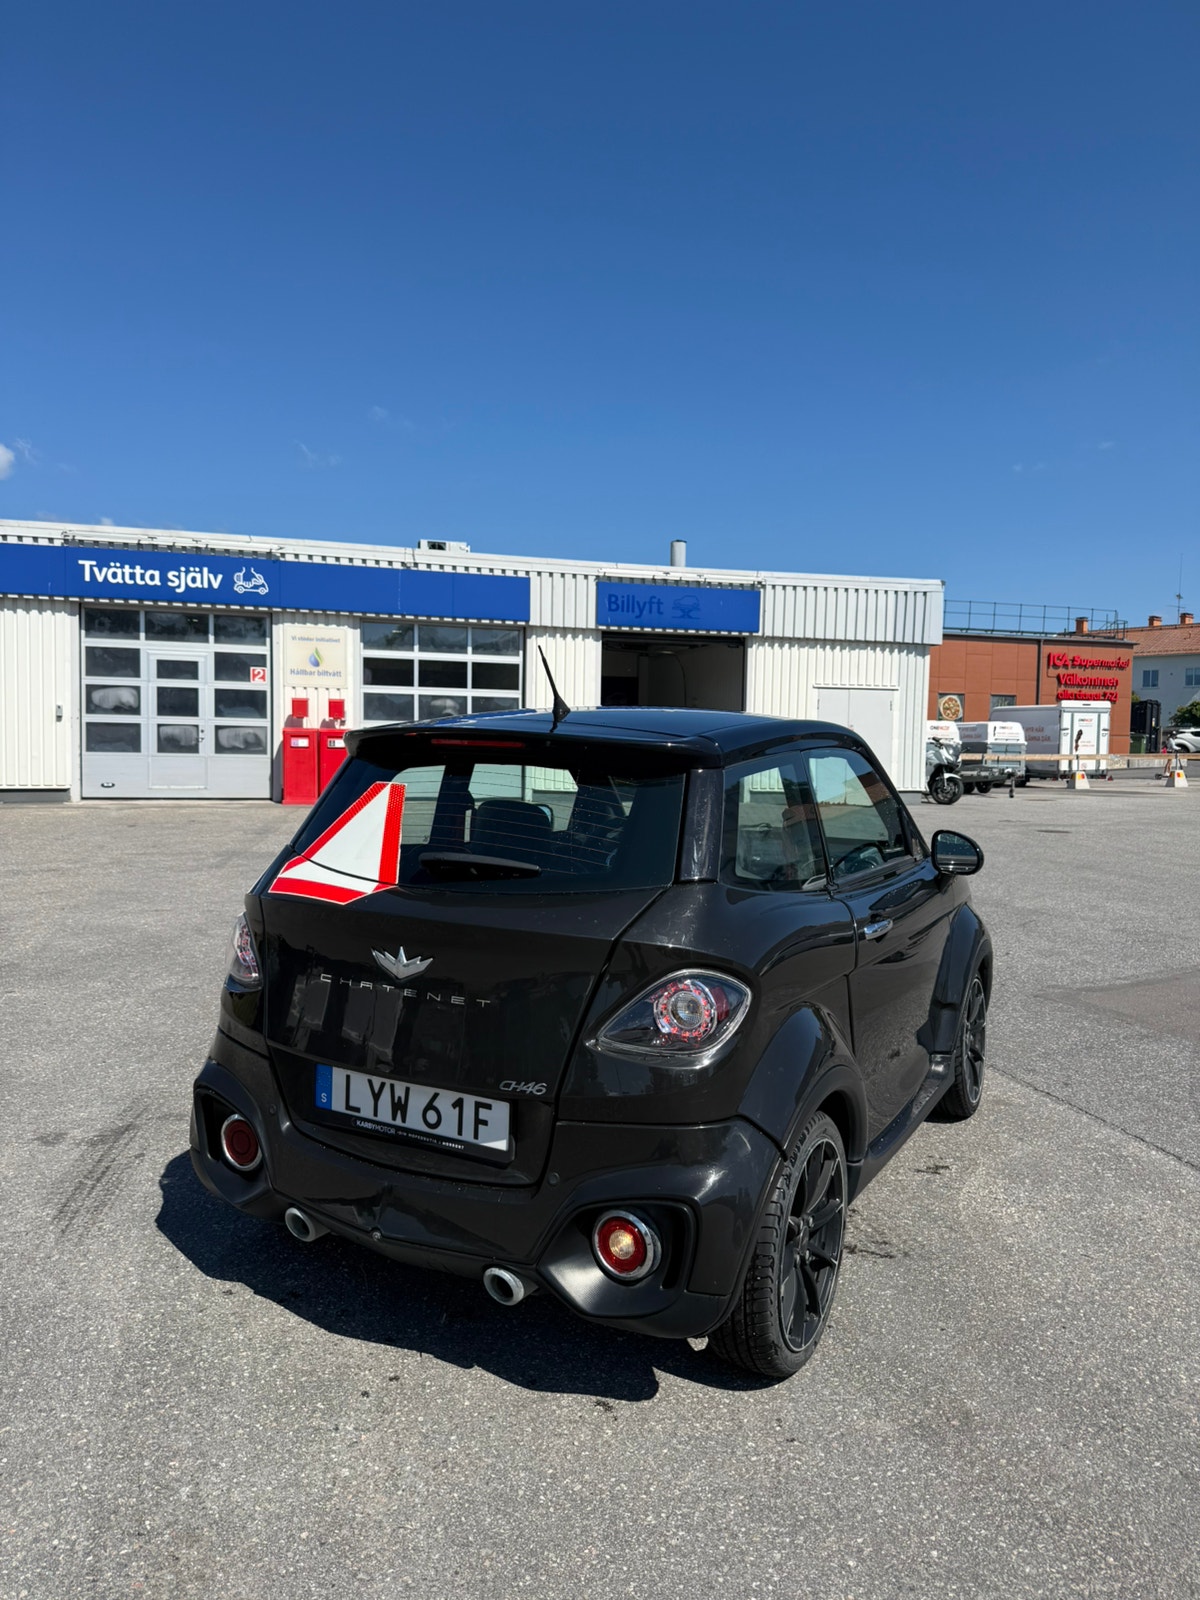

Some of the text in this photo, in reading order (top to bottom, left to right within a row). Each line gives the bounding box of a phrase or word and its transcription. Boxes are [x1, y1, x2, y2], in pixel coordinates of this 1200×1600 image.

[78, 560, 223, 594] Tvätta själv
[607, 593, 664, 619] Billyft
[1048, 652, 1130, 669] ICA Supermarket
[253, 668, 265, 682] 2
[290, 668, 316, 677] Hållbar
[1059, 673, 1118, 688] Välkommen
[320, 973, 491, 1008] CHATENET
[500, 1080, 547, 1095] CH46
[320, 1093, 327, 1103] S
[345, 1074, 493, 1140] LYW 61F
